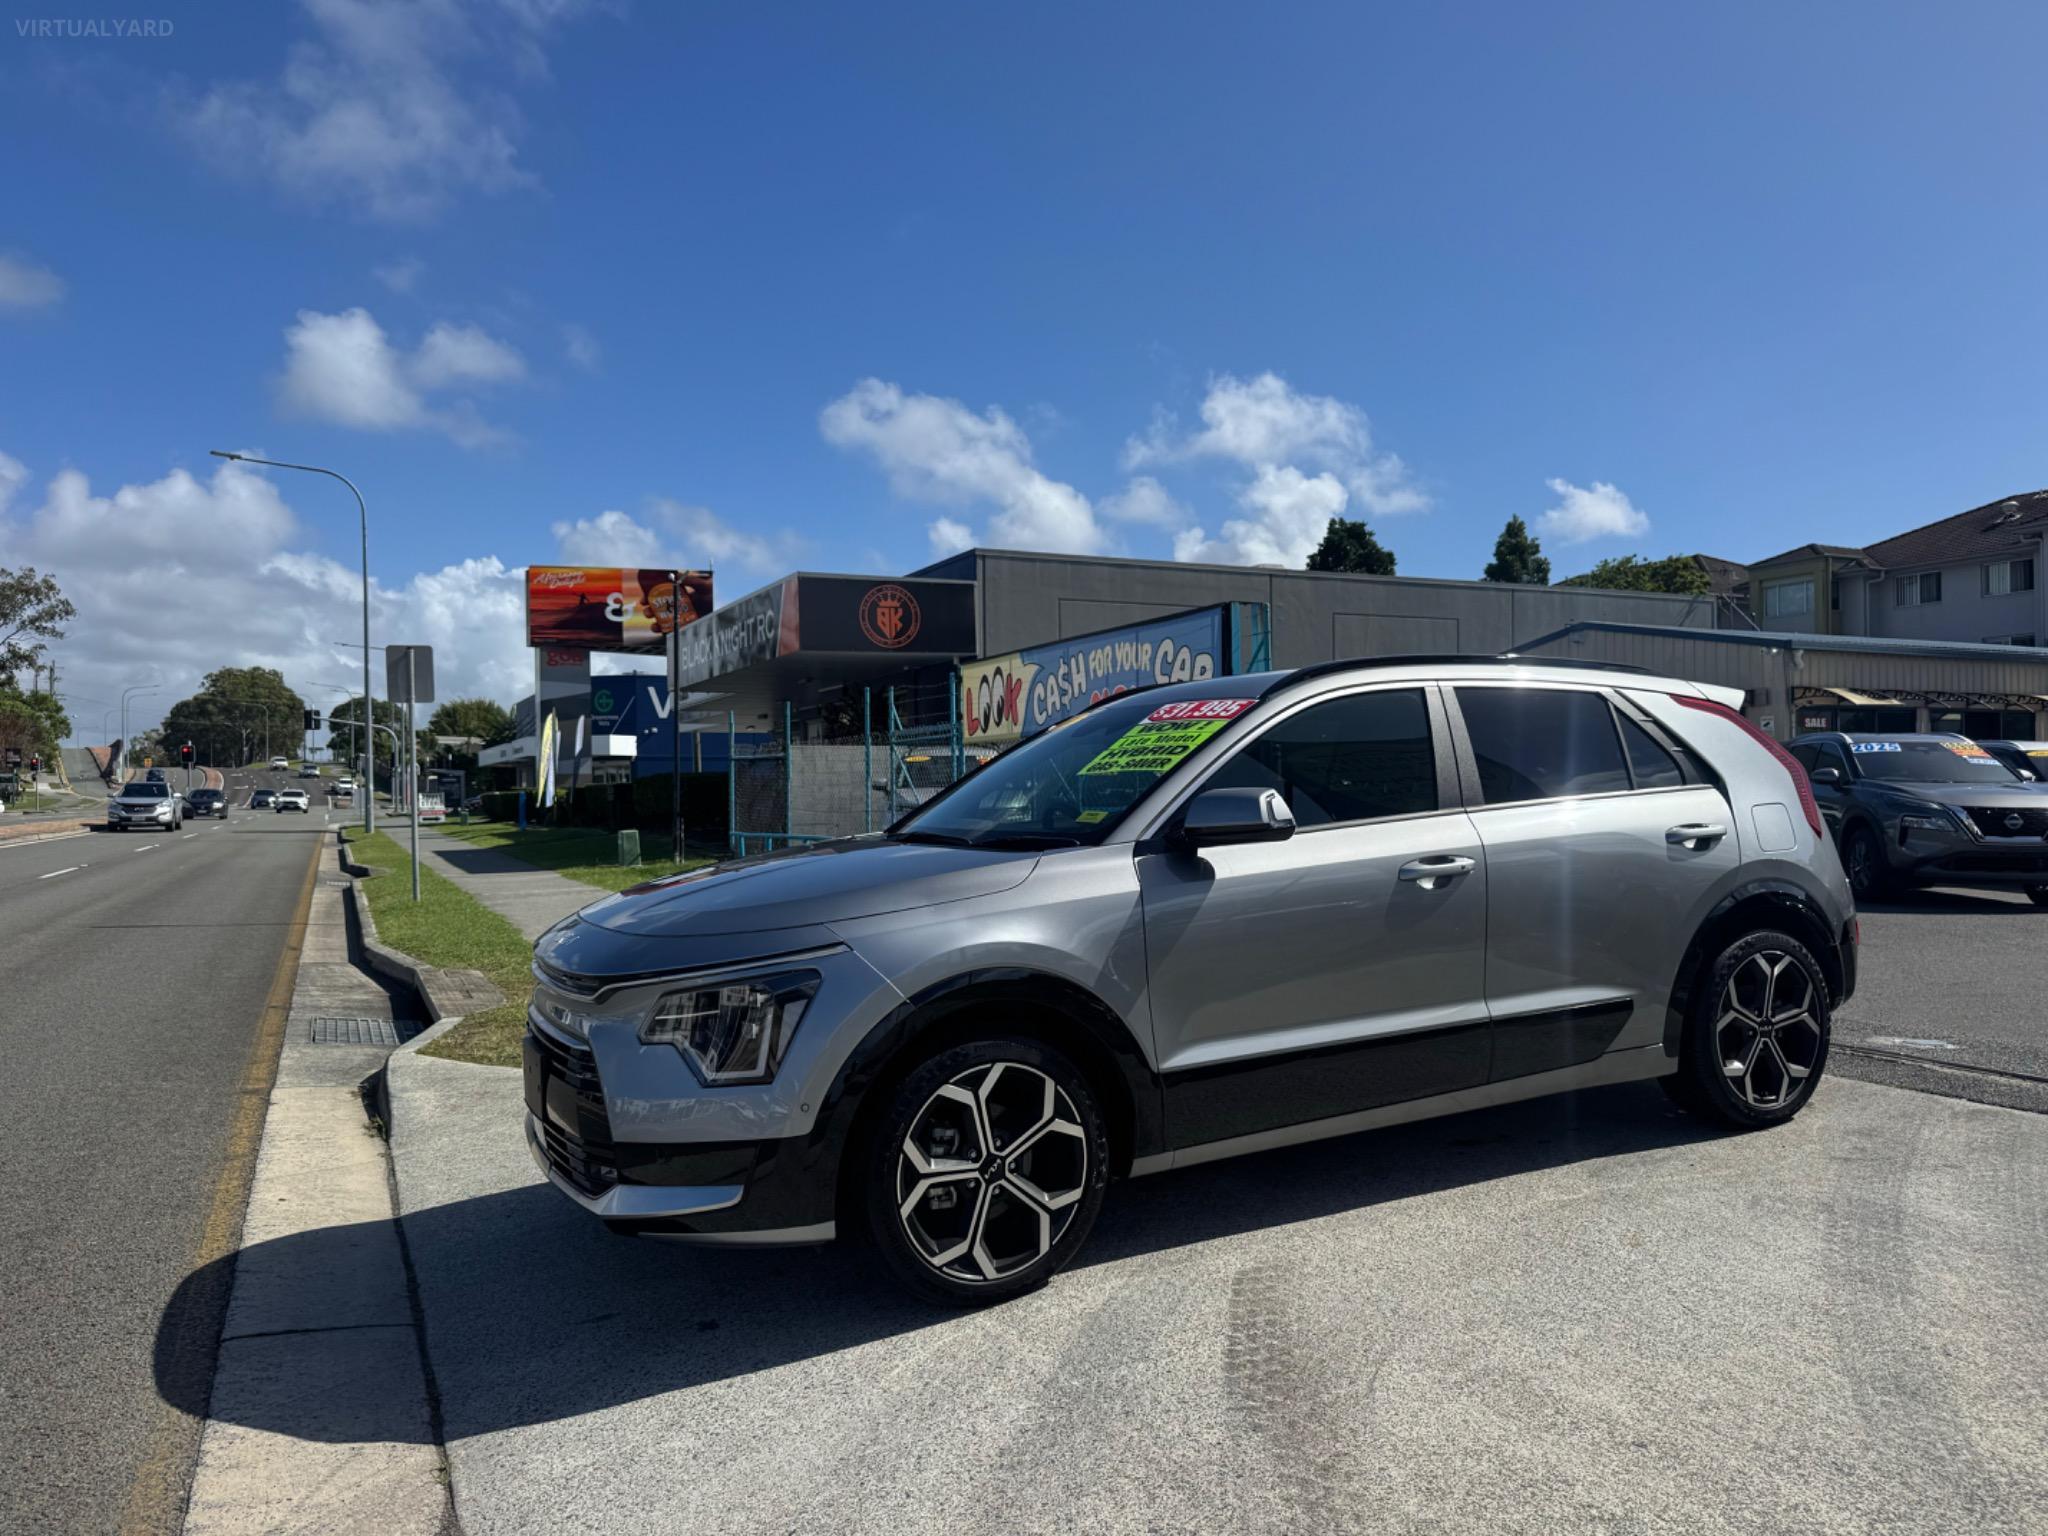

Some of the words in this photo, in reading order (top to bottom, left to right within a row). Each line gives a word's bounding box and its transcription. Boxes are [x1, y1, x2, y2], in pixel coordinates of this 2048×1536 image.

[604, 591, 637, 622] &
[682, 636, 713, 669] BLACK
[713, 619, 757, 660] KNIGHT
[757, 610, 775, 641] RC
[1088, 645, 1112, 680] FOR
[1115, 641, 1152, 673] YOUR
[966, 665, 1022, 736] LOOK
[1136, 720, 1212, 734] WOW!
[1804, 717, 1827, 728] SALE
[1152, 733, 1202, 744] Model
[1098, 745, 1189, 761] HYBRID
[1852, 743, 1900, 752] 2025
